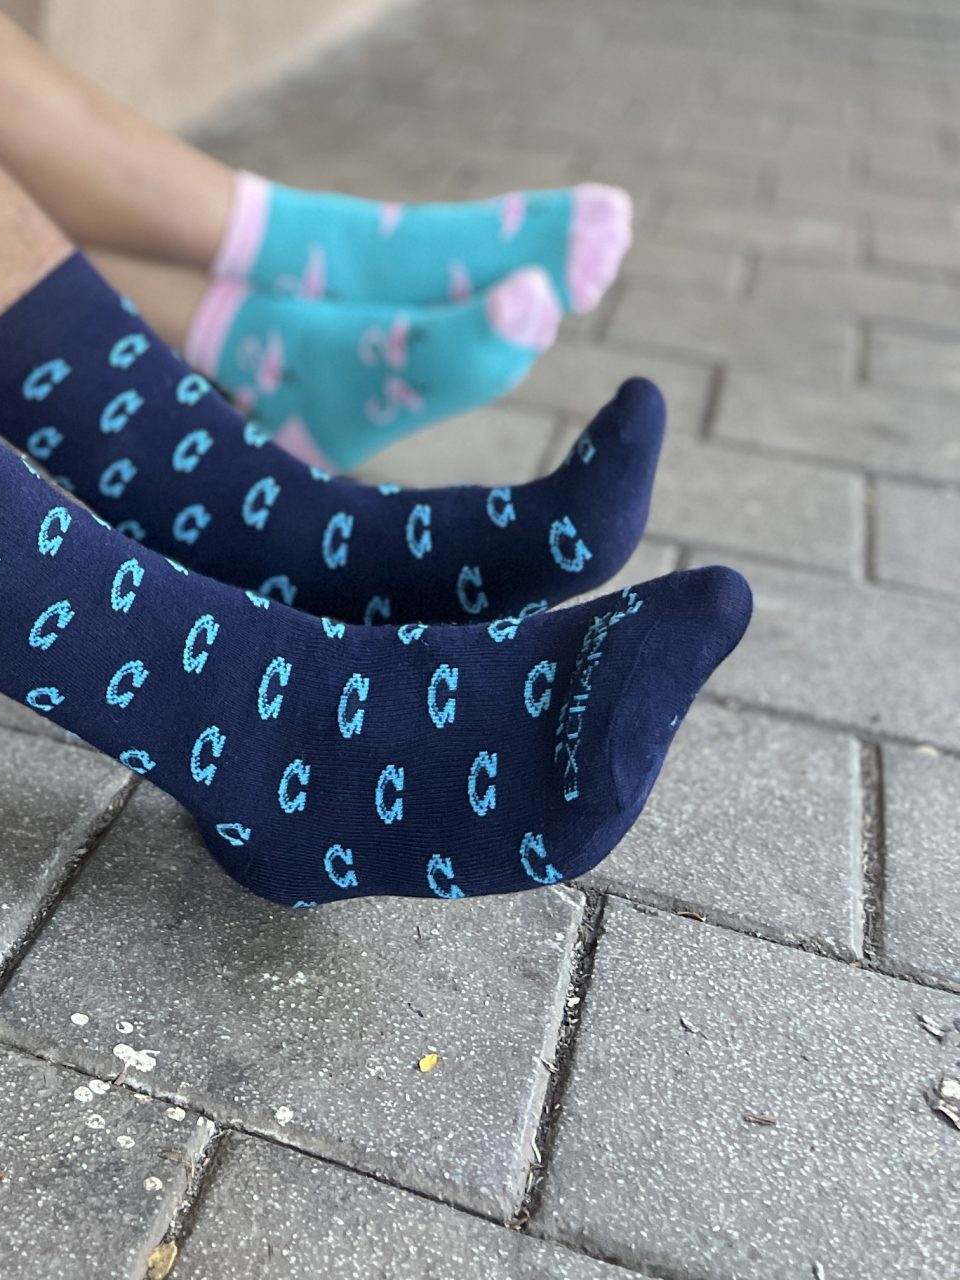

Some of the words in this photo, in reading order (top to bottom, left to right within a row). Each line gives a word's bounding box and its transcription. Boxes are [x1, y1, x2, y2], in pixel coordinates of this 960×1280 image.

[109, 332, 151, 370] C
[23, 358, 71, 401] C
[100, 389, 145, 433] C
[99, 458, 137, 499] C
[172, 429, 215, 473] C
[37, 505, 72, 557] C
[172, 503, 211, 545] C
[242, 476, 280, 530] C
[406, 503, 432, 559] C
[322, 511, 354, 569] C
[548, 515, 592, 573] C
[110, 557, 145, 614] C
[28, 599, 75, 651] C
[182, 613, 220, 674] C
[106, 659, 150, 709] C
[257, 656, 292, 721] C
[337, 672, 371, 739] C
[427, 663, 459, 729] C
[524, 660, 557, 718] C
[190, 724, 227, 787] C
[277, 758, 312, 814] C
[375, 764, 405, 825] C
[467, 751, 498, 817] C
[323, 843, 359, 888] C
[520, 831, 564, 885] C
